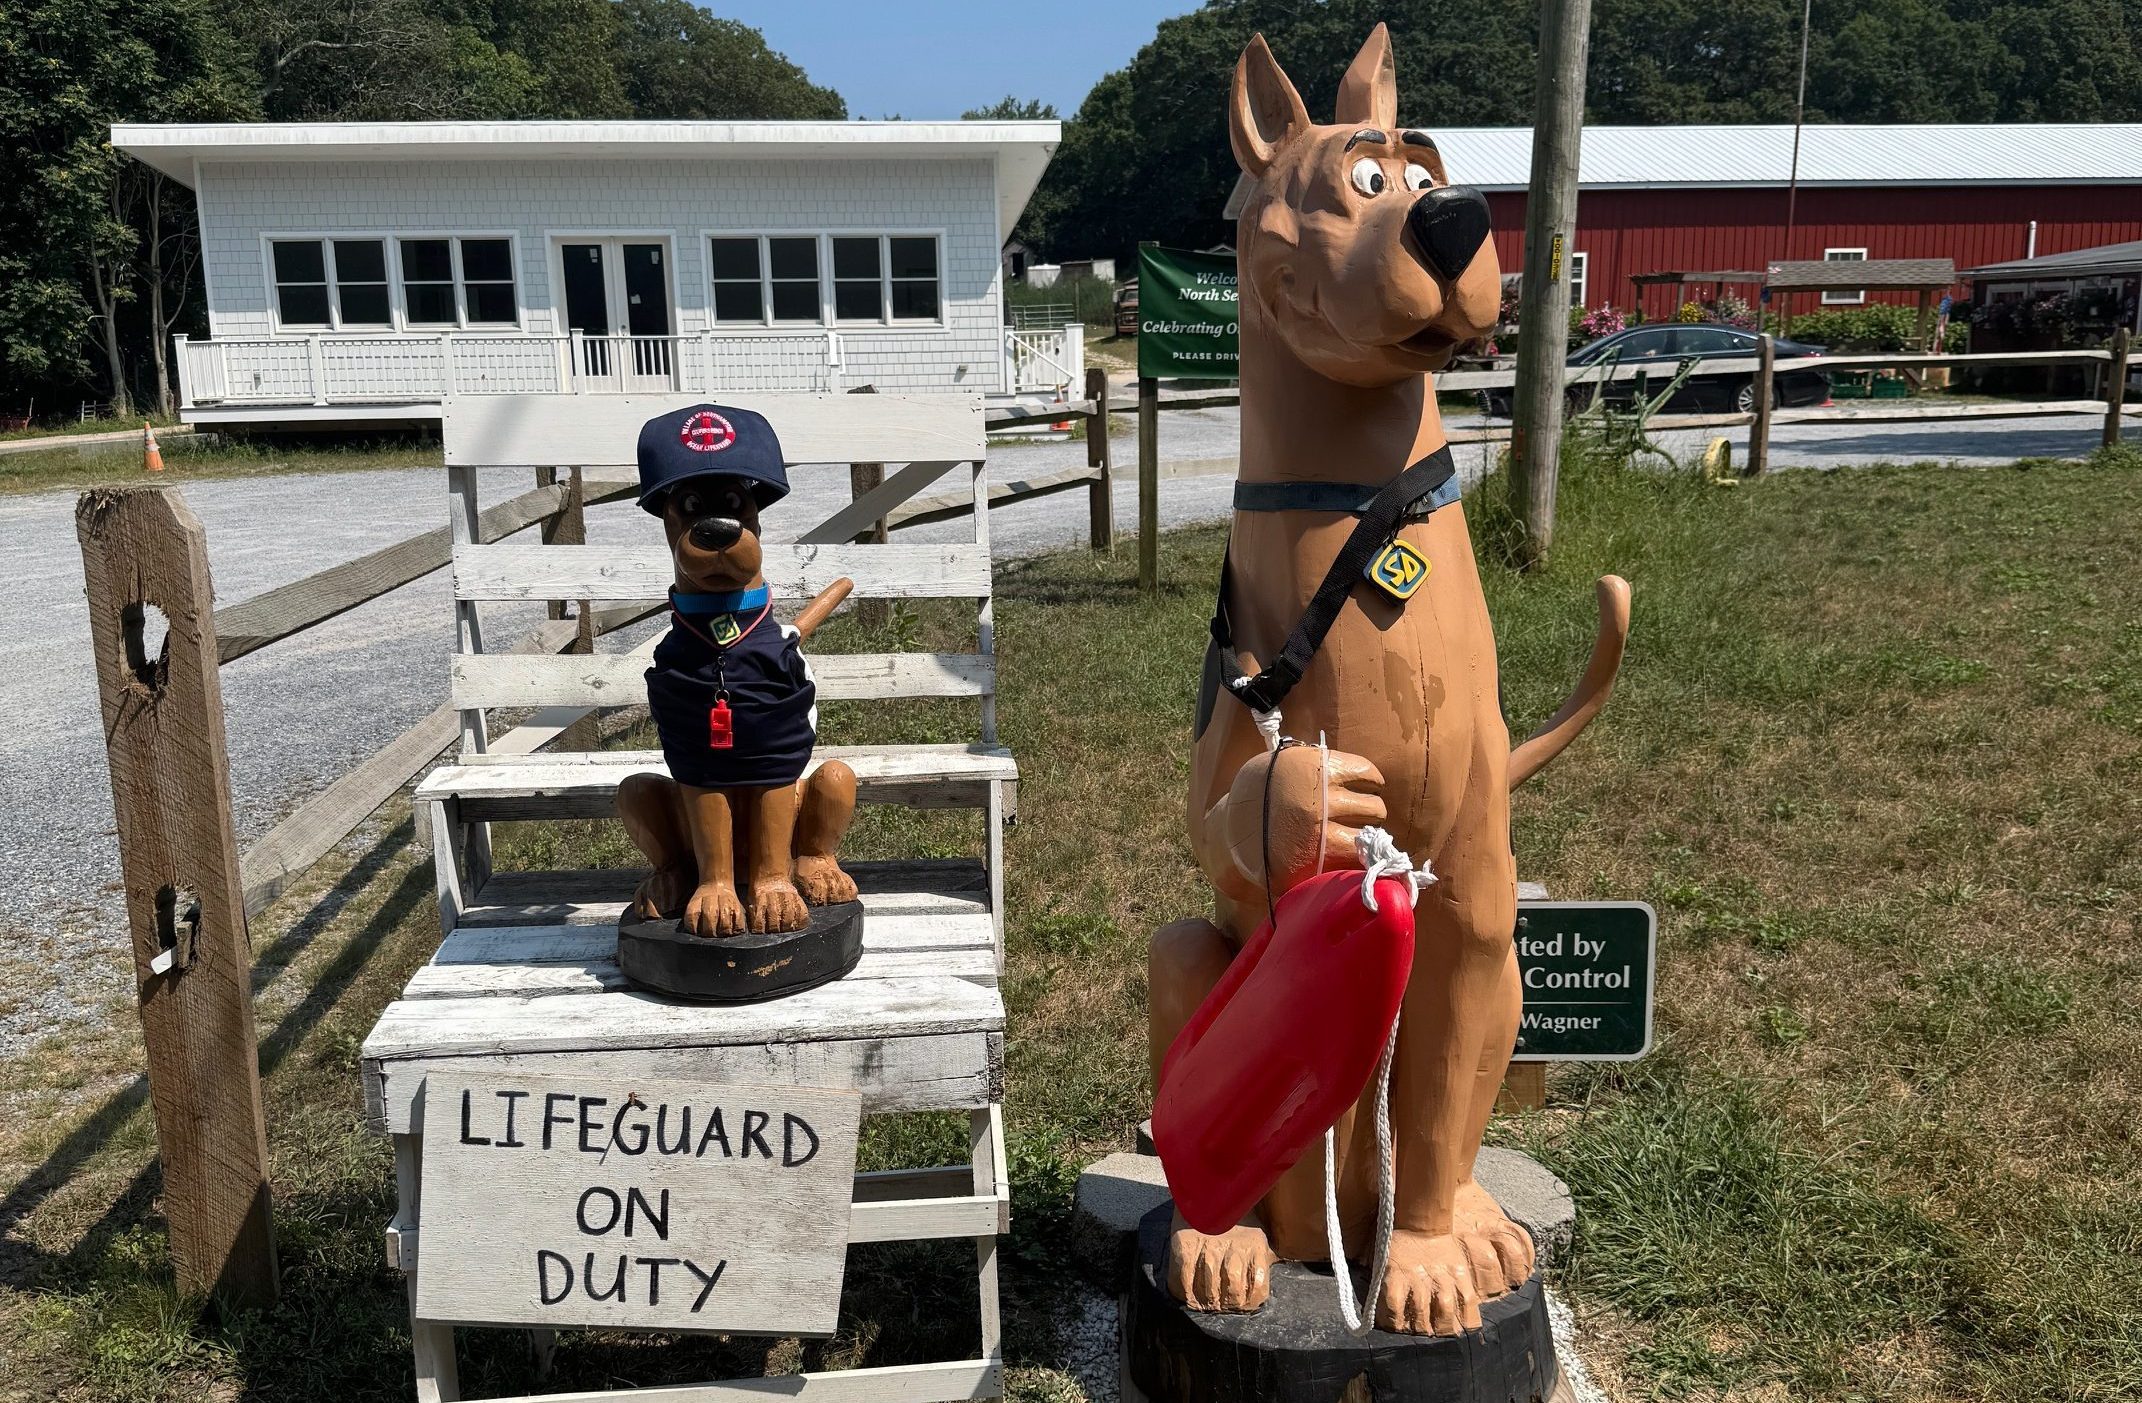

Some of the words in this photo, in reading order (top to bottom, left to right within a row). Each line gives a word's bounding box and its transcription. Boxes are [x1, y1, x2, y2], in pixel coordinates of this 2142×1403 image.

[1178, 288, 1220, 301] North
[1221, 288, 1240, 302] Se
[1142, 321, 1224, 338] Celebrating
[1226, 322, 1240, 335] O
[1172, 351, 1212, 360] PLEASE
[1515, 932, 1563, 957] ted
[1574, 932, 1606, 962] by
[1524, 965, 1630, 989] Control
[1521, 1012, 1601, 1034] Wagner
[460, 1088, 820, 1168] LIFEGUARD
[576, 1186, 670, 1241] ON
[537, 1249, 727, 1313] DUTY
